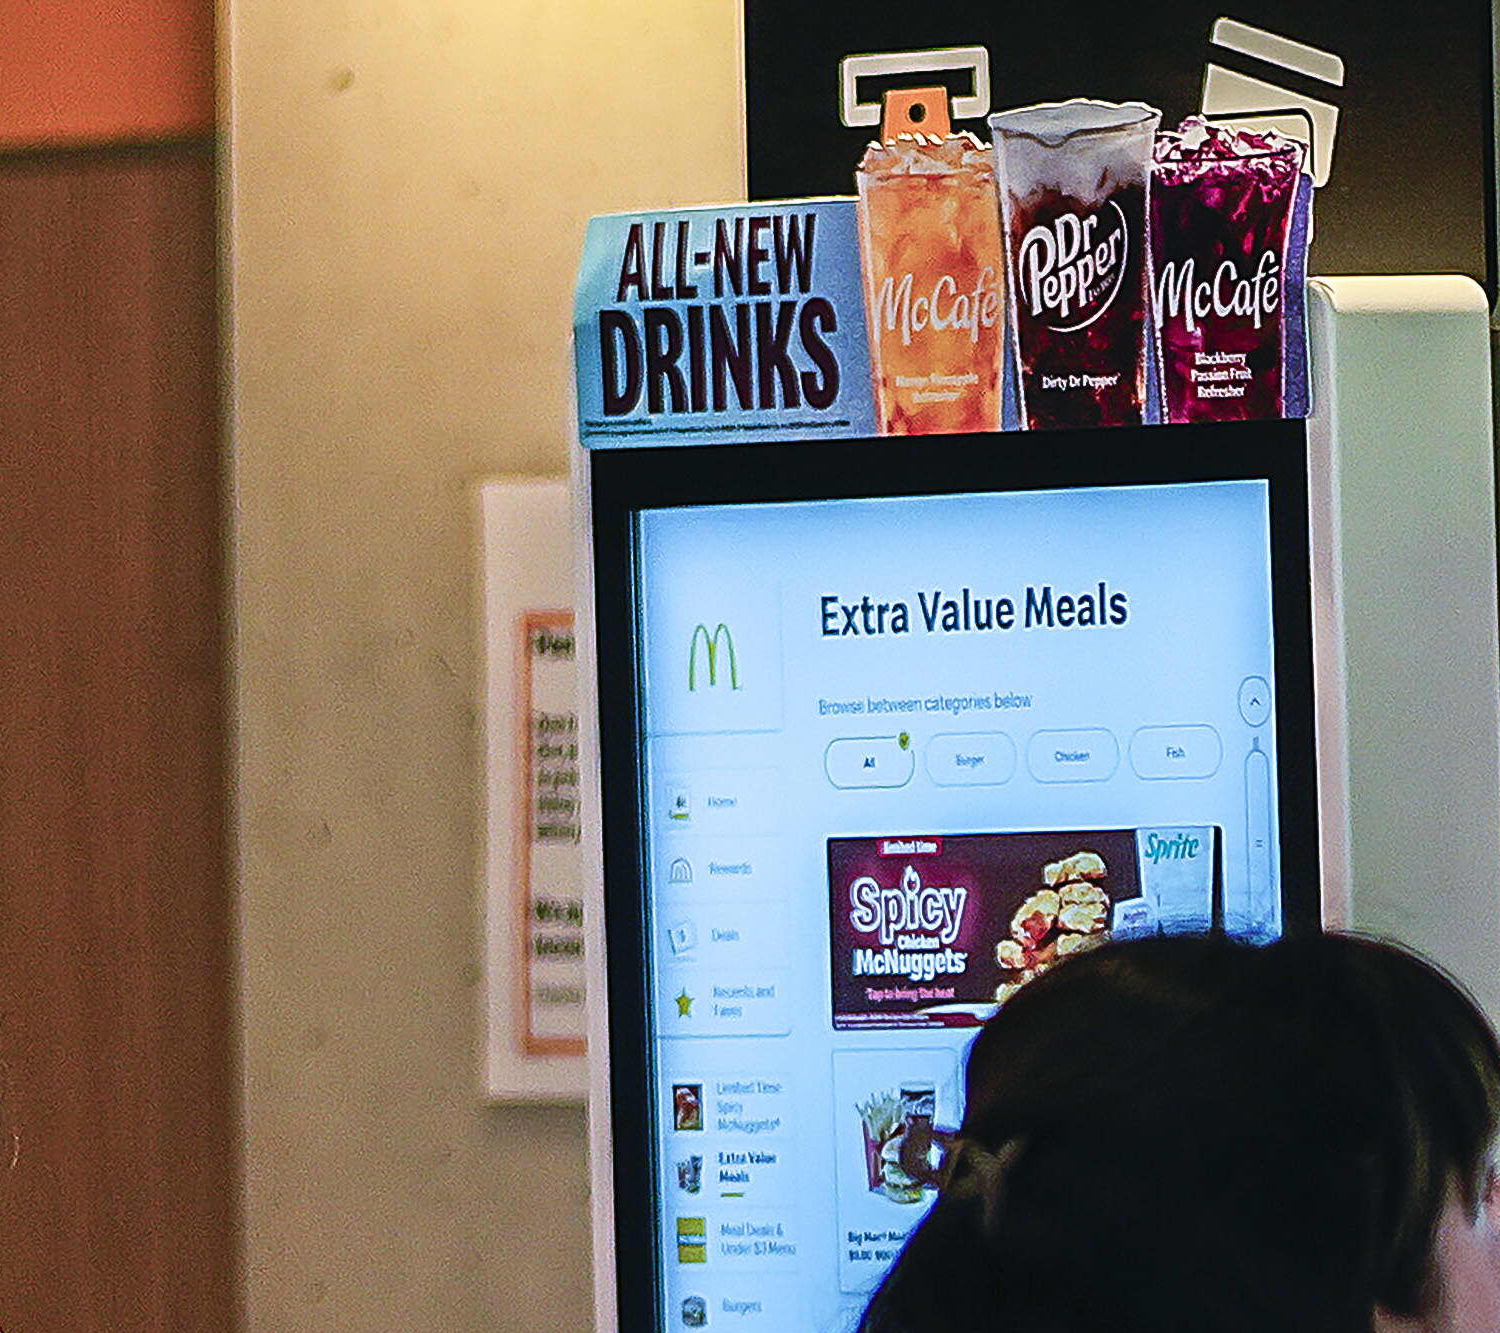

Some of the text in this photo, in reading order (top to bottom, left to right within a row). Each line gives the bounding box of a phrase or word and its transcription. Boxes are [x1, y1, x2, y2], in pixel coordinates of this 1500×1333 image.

[617, 212, 817, 302] ALL-NEW
[1019, 225, 1121, 318] Pepper
[1055, 213, 1098, 268] Dr
[601, 295, 841, 416] DRINKS
[821, 581, 1128, 636] Extra Value Meals
[819, 693, 1032, 716] Browse between categories below
[1145, 833, 1200, 864] Sprite
[851, 865, 967, 945] Spicy
